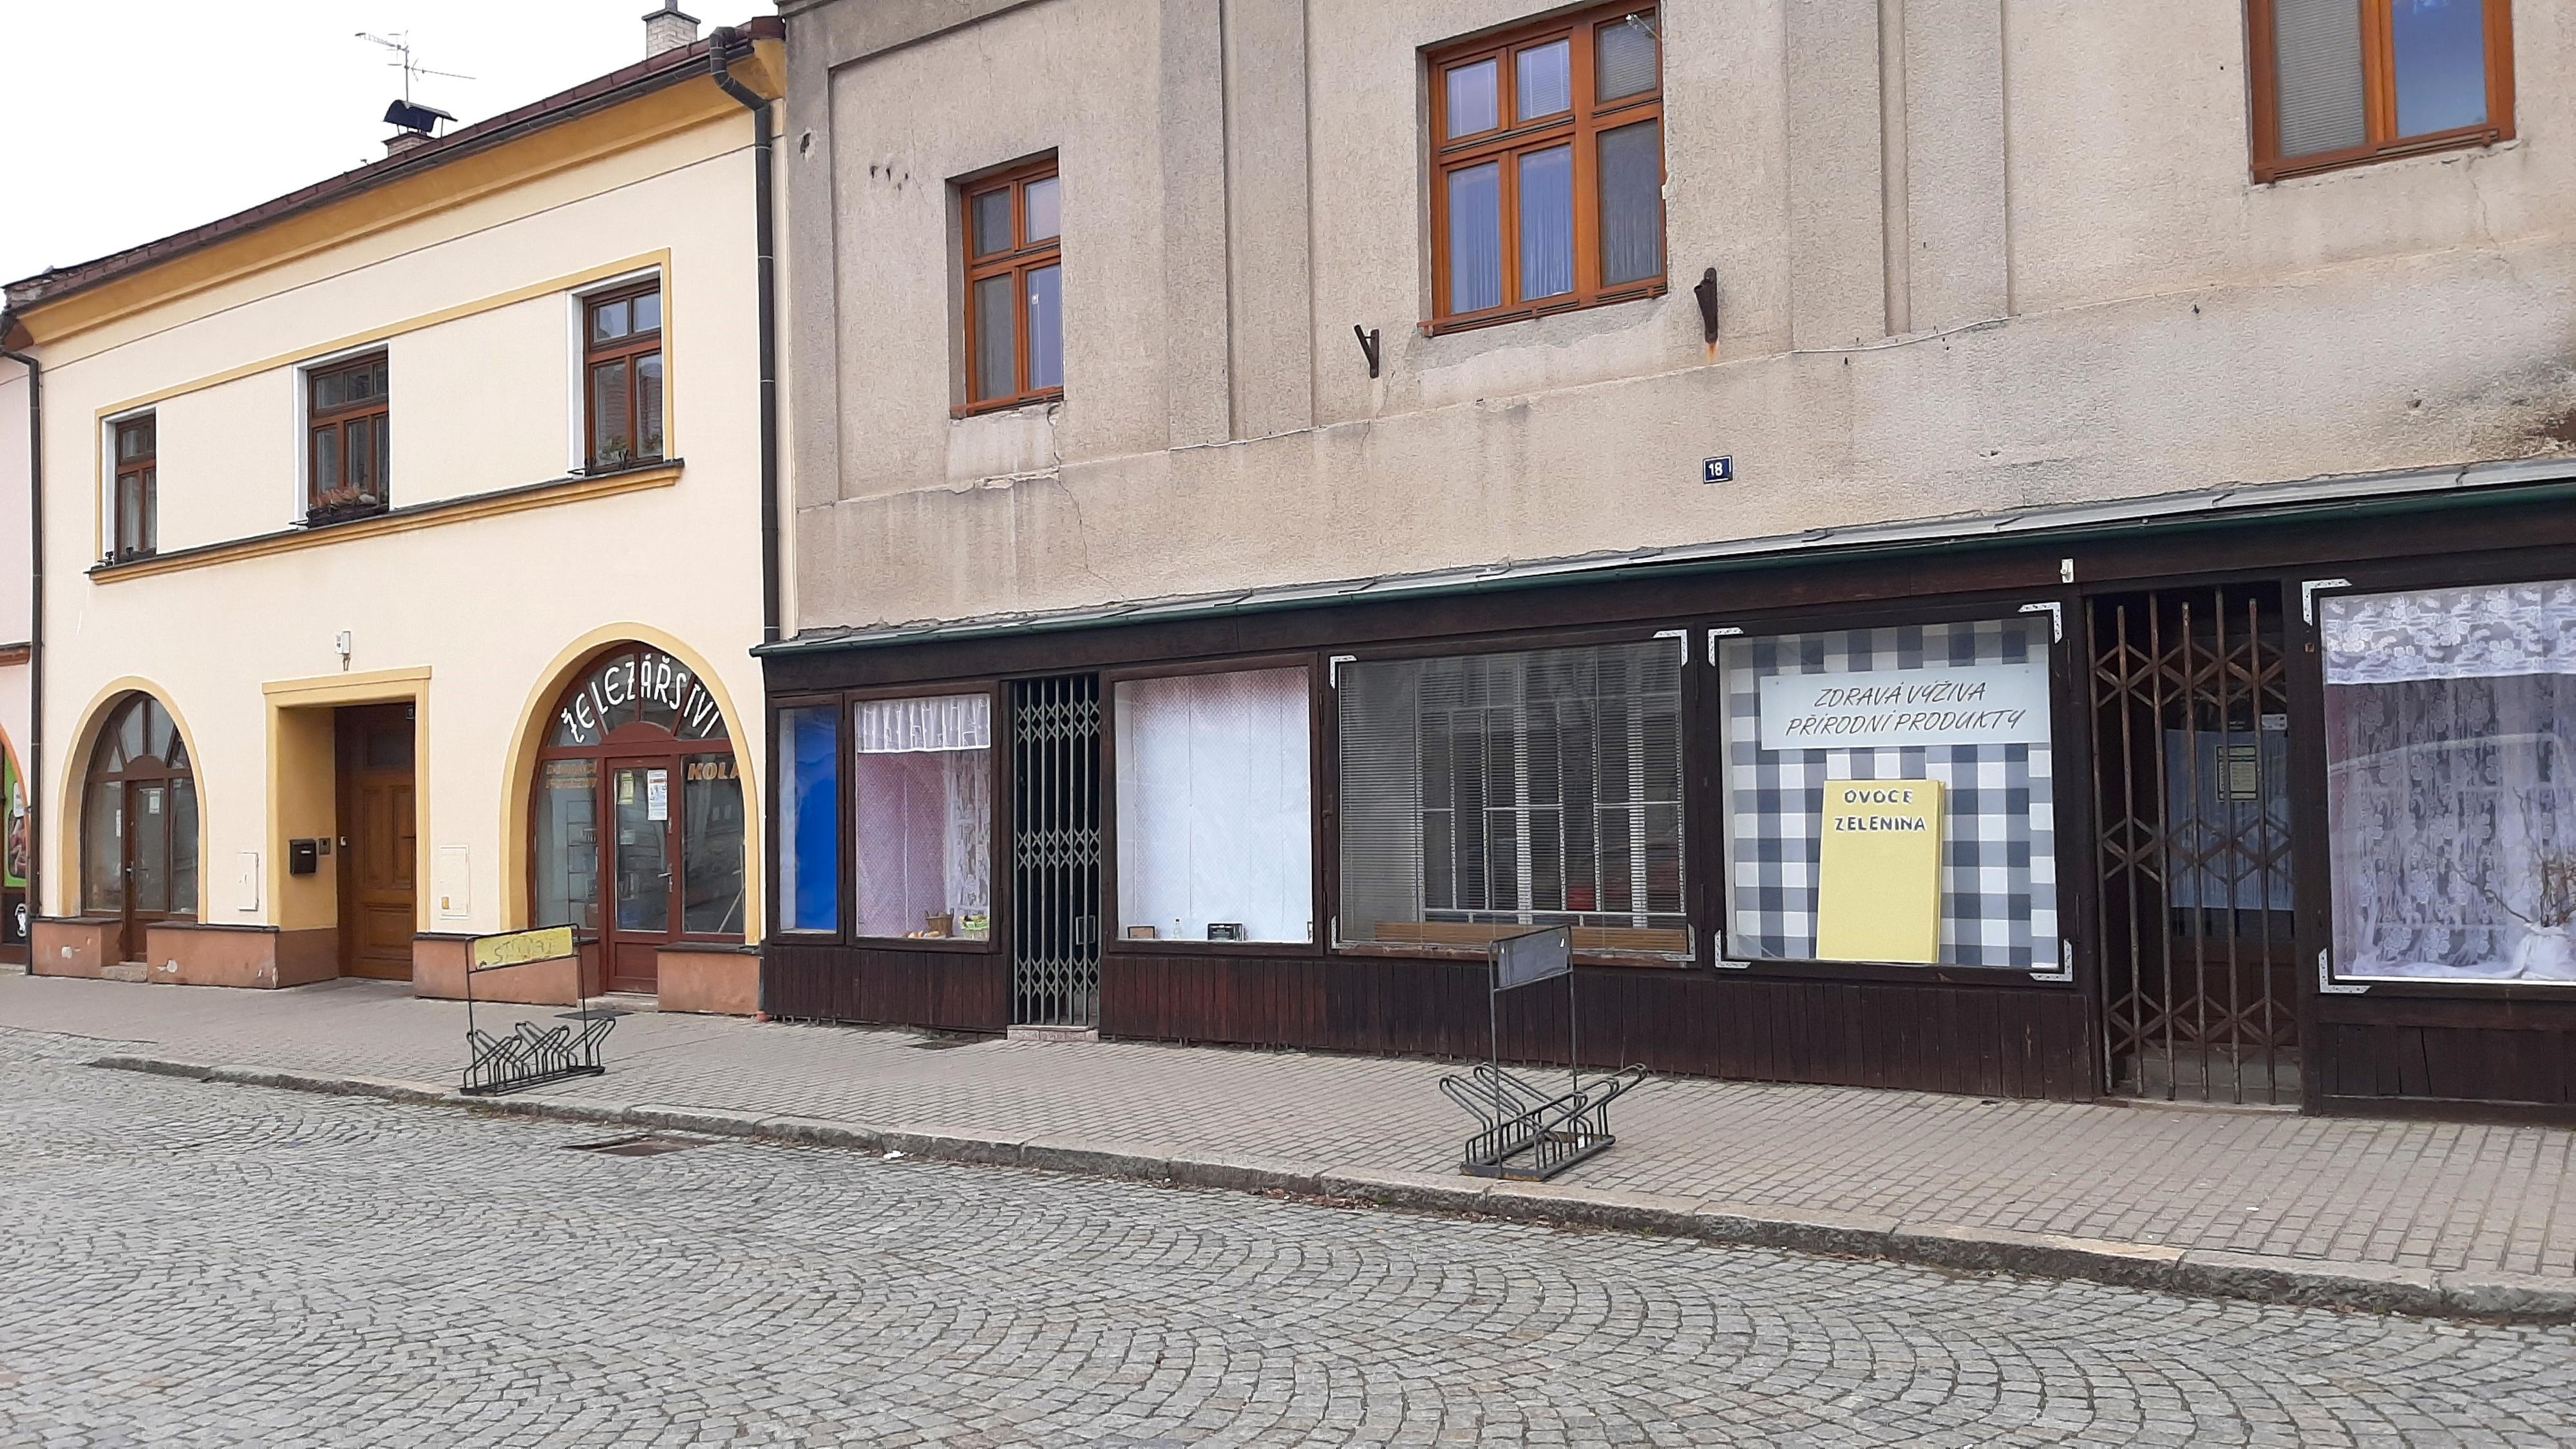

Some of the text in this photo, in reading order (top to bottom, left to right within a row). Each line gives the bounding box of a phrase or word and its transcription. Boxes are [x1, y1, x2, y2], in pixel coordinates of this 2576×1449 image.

[1708, 462, 1723, 477] 18
[1814, 679, 1987, 707] ZDRAVÁ VÝŽIVA
[1785, 709, 2027, 737] PŘÍRODNÍ PRODUKTY
[1844, 790, 1913, 804] OVOCE
[1835, 816, 1926, 831] ZELENINA
